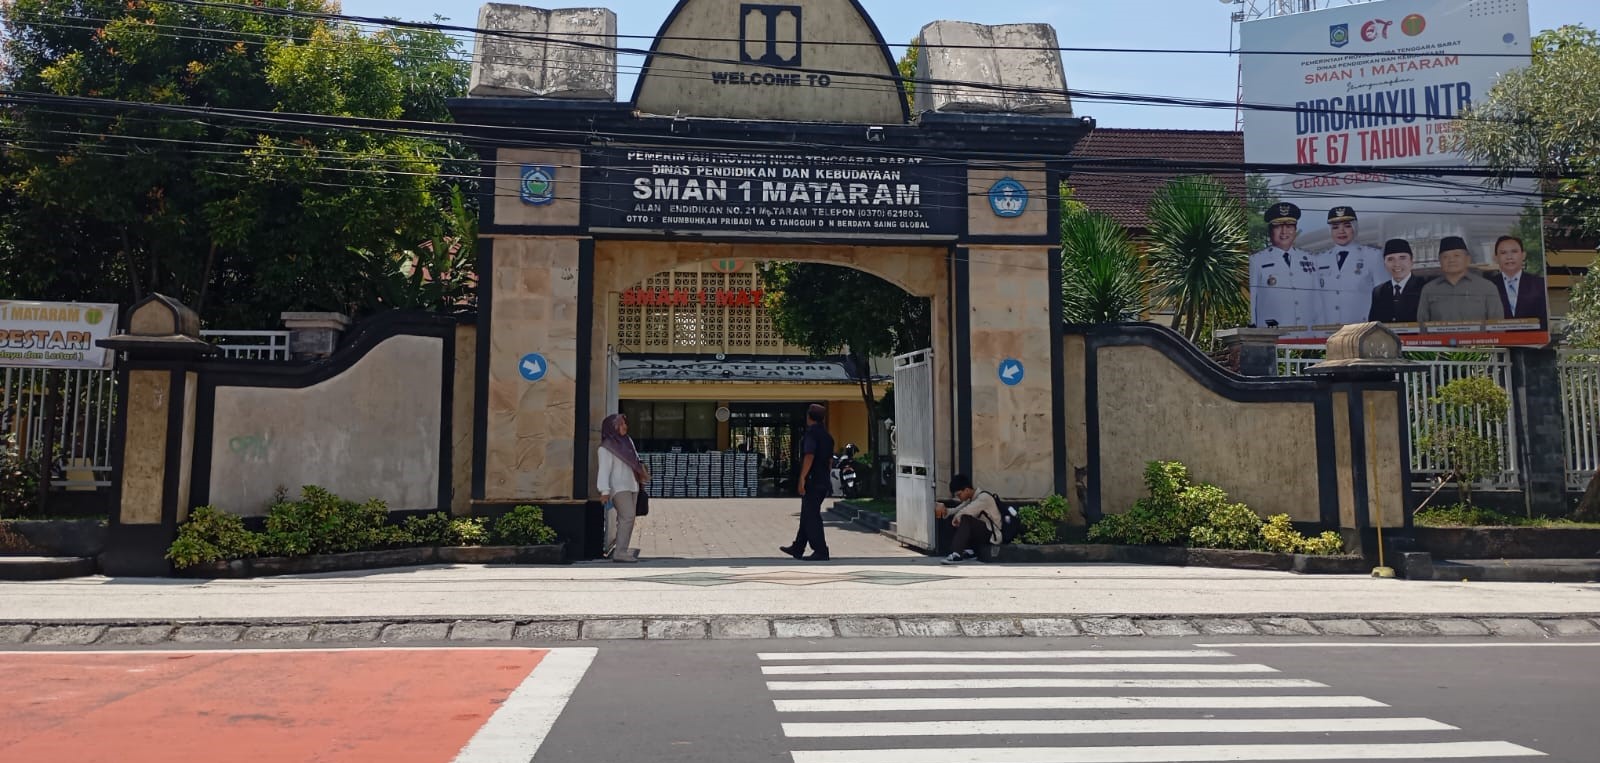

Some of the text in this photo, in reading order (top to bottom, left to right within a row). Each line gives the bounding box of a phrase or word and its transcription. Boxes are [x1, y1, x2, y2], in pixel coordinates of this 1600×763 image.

[1397, 44, 1437, 53] TENGGARA
[1437, 40, 1461, 48] BARAT
[1304, 56, 1459, 85] SMAN 1 MATARAM
[1316, 63, 1337, 71] DINAS
[1338, 57, 1380, 68] PENDIDIKAN
[711, 71, 831, 88] WELCOME TO
[1295, 88, 1416, 136] DIRGAHAYU
[1296, 126, 1421, 166] KE 67 TAHUN
[652, 164, 901, 181] DINAS PENDIDIKAN DAN KEBUDAYAAN
[1292, 174, 1340, 190] GERAK
[632, 176, 920, 206] SMAN 1 MATARAM
[634, 203, 661, 213] ALAN
[669, 204, 723, 215] ENDIDIKAN
[726, 206, 743, 215] NO.
[745, 206, 756, 215] 21
[812, 207, 856, 218] TELEPON
[858, 208, 885, 218] (0370)
[662, 215, 718, 225] ENUMBUHKAN
[720, 216, 752, 226] PRIBADI
[779, 219, 816, 228] TANGGUH
[837, 219, 872, 229] BERDAYA
[874, 220, 897, 229] SAING
[900, 220, 930, 229] GLOBAL
[623, 287, 689, 306] SMAN
[11, 305, 80, 322] MATARAM
[0, 329, 92, 350] BESTARI
[24, 351, 43, 360] dan
